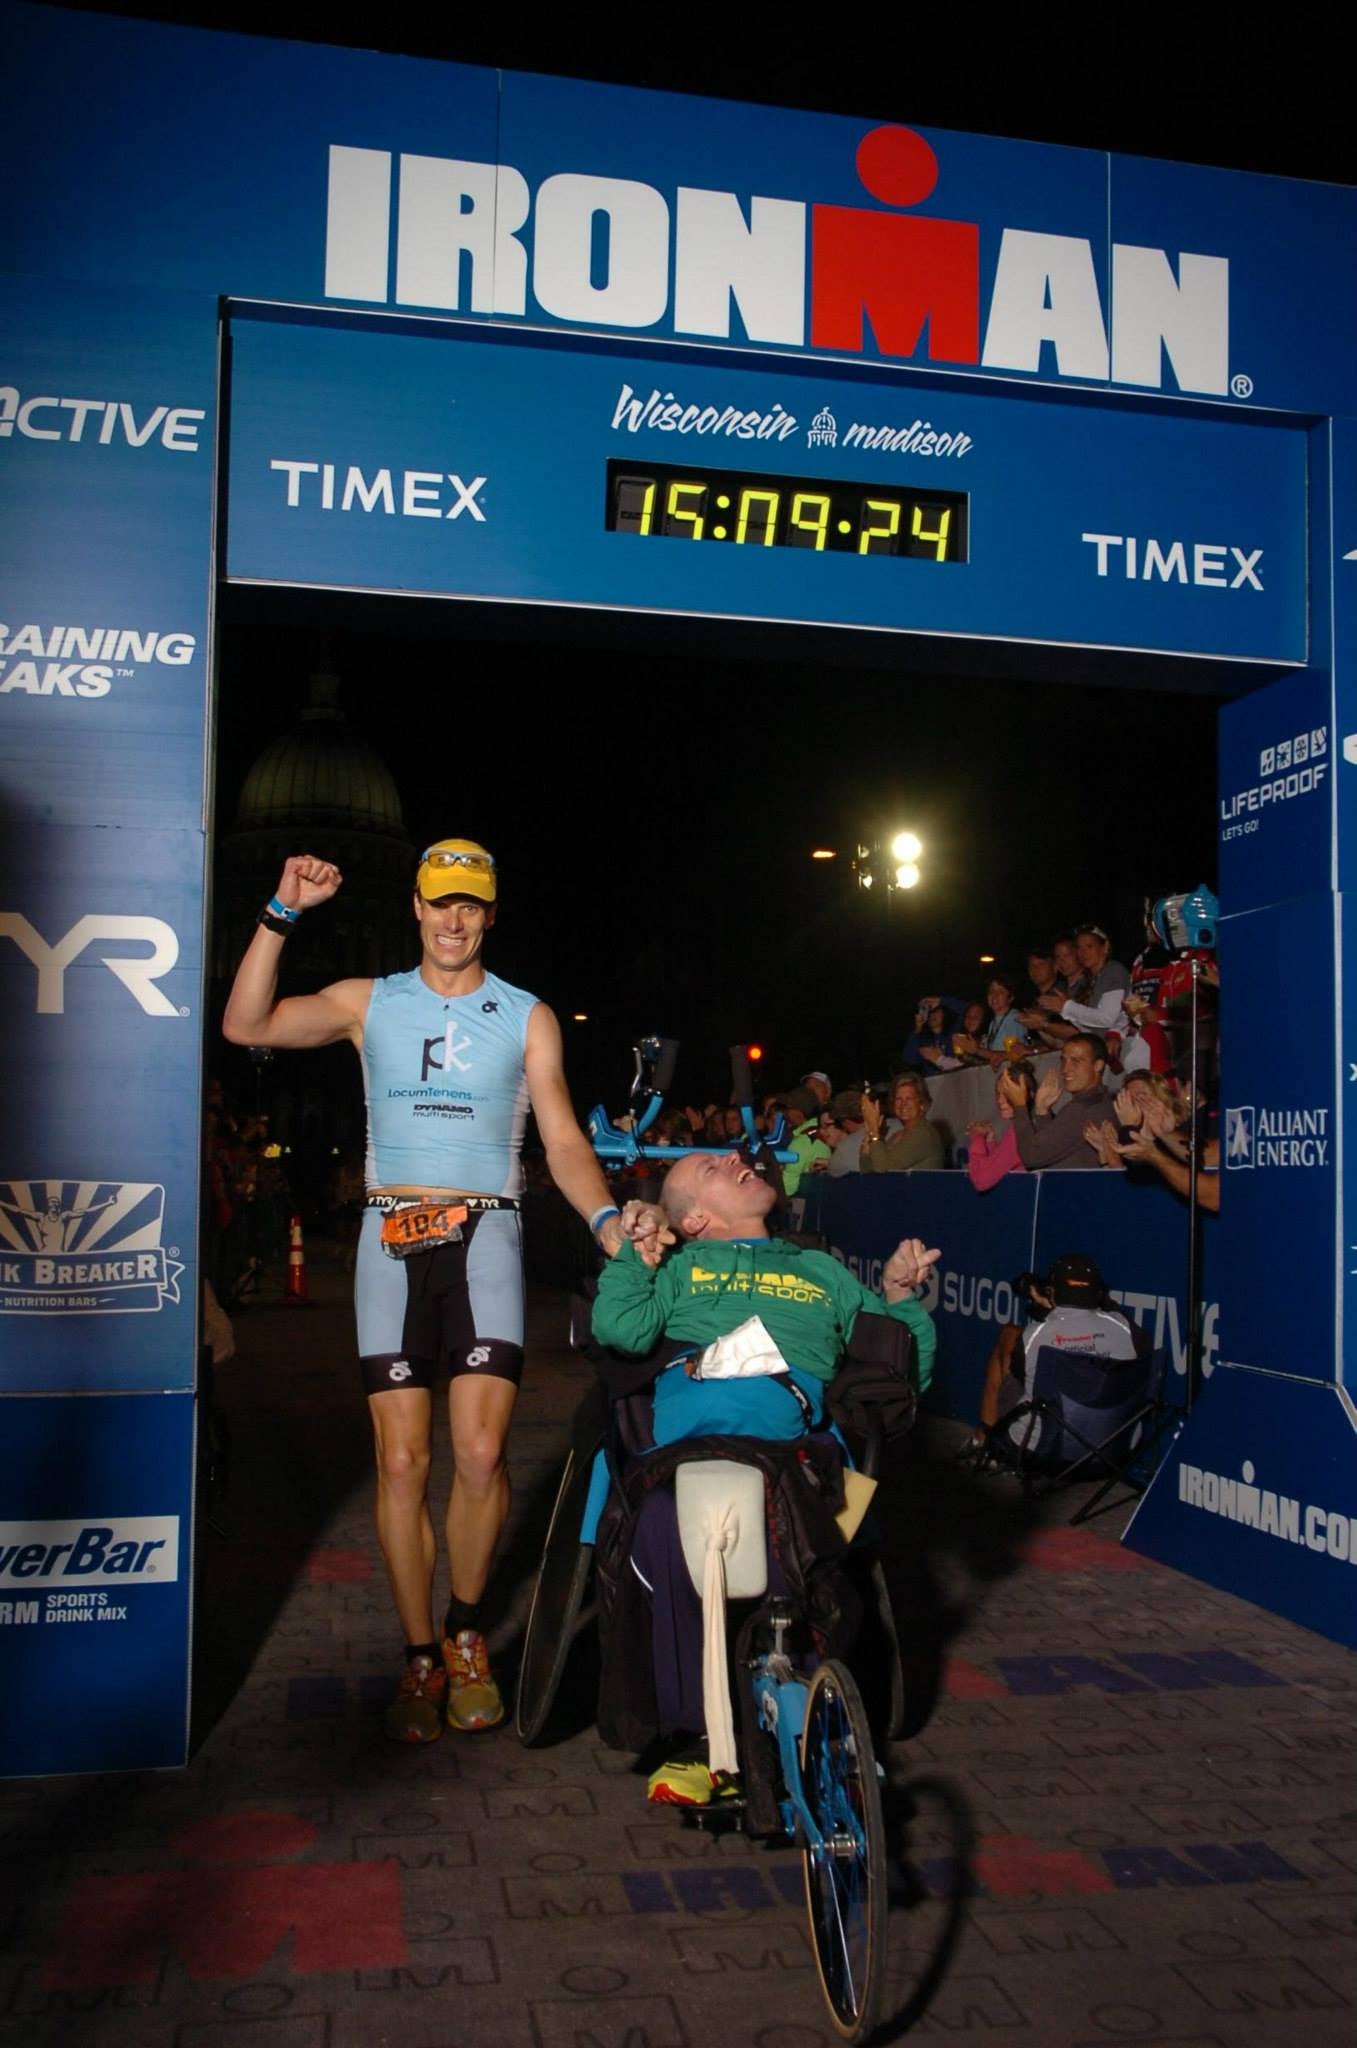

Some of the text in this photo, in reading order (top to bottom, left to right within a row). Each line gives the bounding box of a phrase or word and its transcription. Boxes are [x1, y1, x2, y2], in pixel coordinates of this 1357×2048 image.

[324, 125, 1230, 397] IRONMAN
[611, 383, 974, 459] Wisconsin madison
[270, 460, 488, 521] TIMEX
[1082, 533, 1265, 591] TIMEX
[0, 660, 114, 698] AKS
[1220, 762, 1329, 821] LIFEPROOF
[1256, 1107, 1329, 1138] ALLIANT
[1256, 1139, 1328, 1168] ENERGY
[479, 1198, 500, 1209] TYR
[35, 1254, 158, 1284] BREAKER
[4, 1296, 97, 1308] NUTRITION BARS
[45, 1608, 94, 1624] DRINK
[96, 1606, 127, 1621] MIX
[46, 1592, 109, 1608] SPORTS
